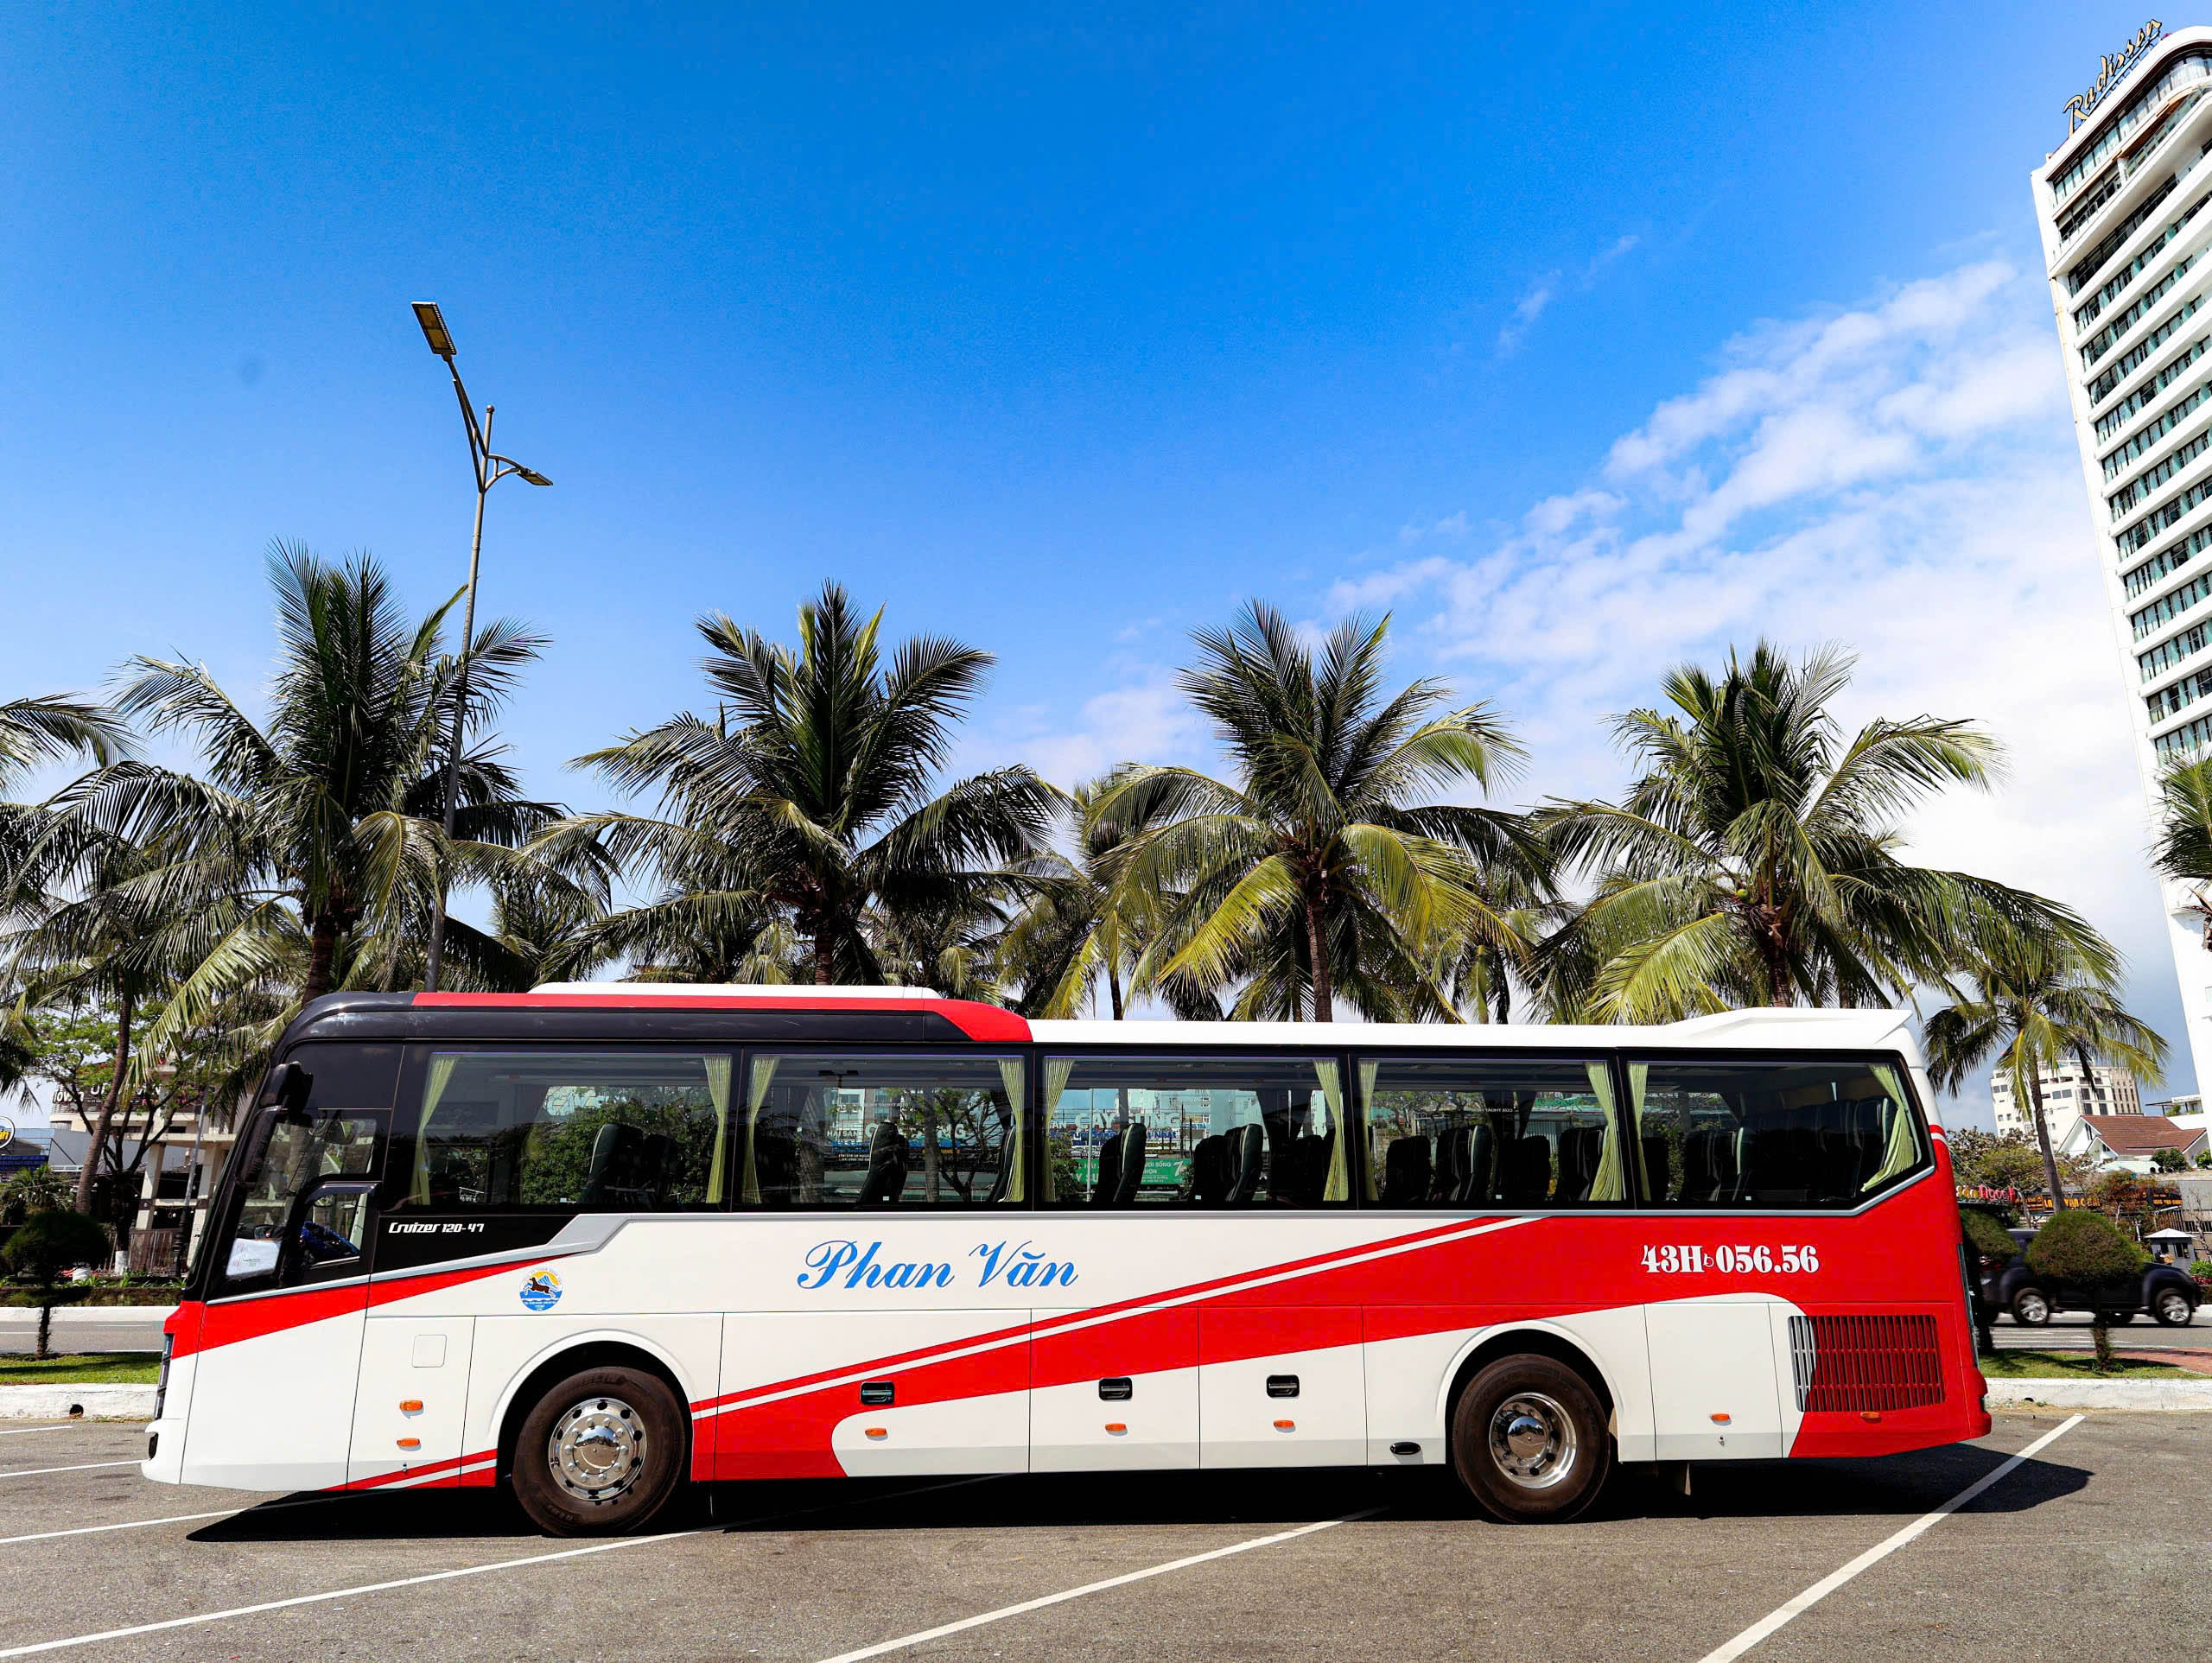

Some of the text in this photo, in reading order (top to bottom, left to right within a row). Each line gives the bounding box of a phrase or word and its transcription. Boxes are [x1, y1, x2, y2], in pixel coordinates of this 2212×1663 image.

[2063, 18, 2163, 138] Radisson
[388, 1222, 441, 1234] Cruizer
[797, 1240, 1078, 1289] Phan Văn
